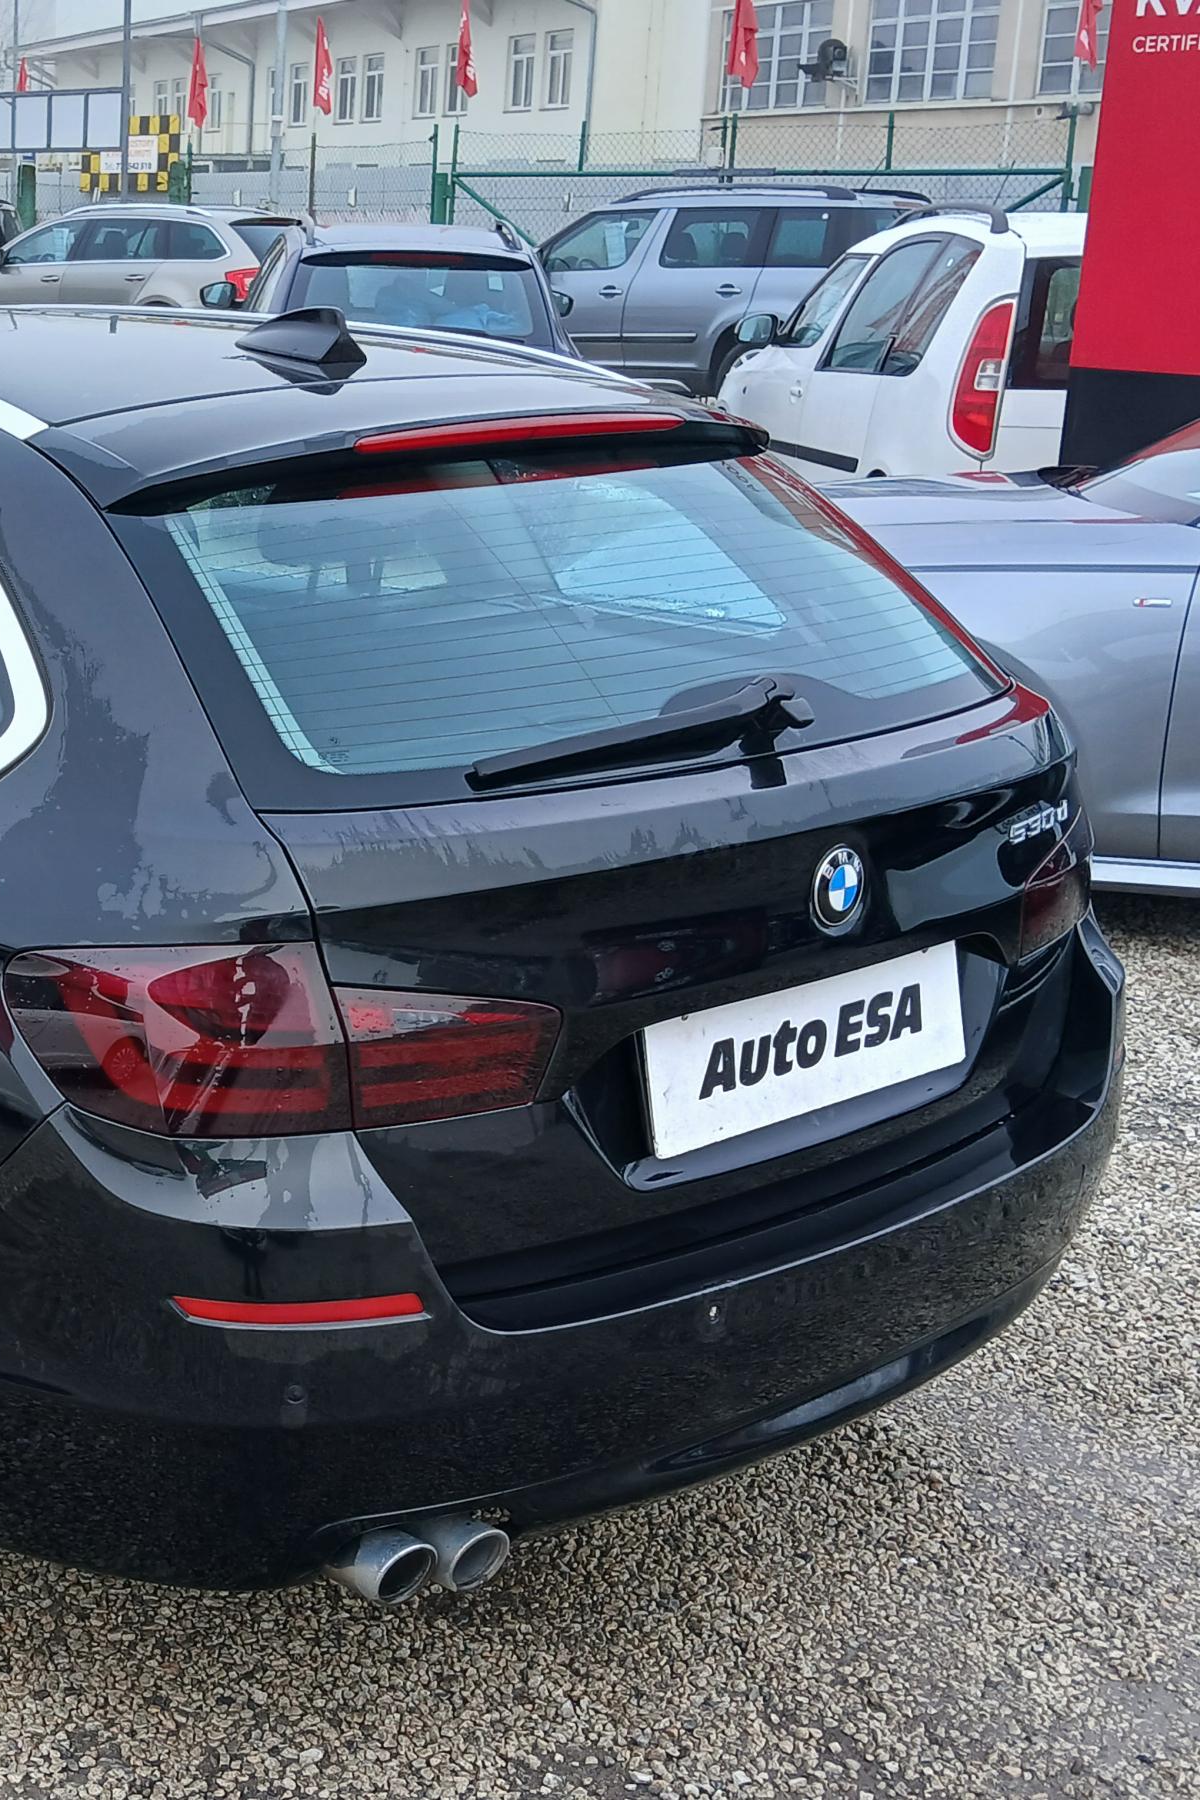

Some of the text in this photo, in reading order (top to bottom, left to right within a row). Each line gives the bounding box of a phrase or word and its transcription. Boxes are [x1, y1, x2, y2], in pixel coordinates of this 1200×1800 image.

[821, 851, 862, 880] BMW
[698, 983, 923, 1101] Auto ESA
